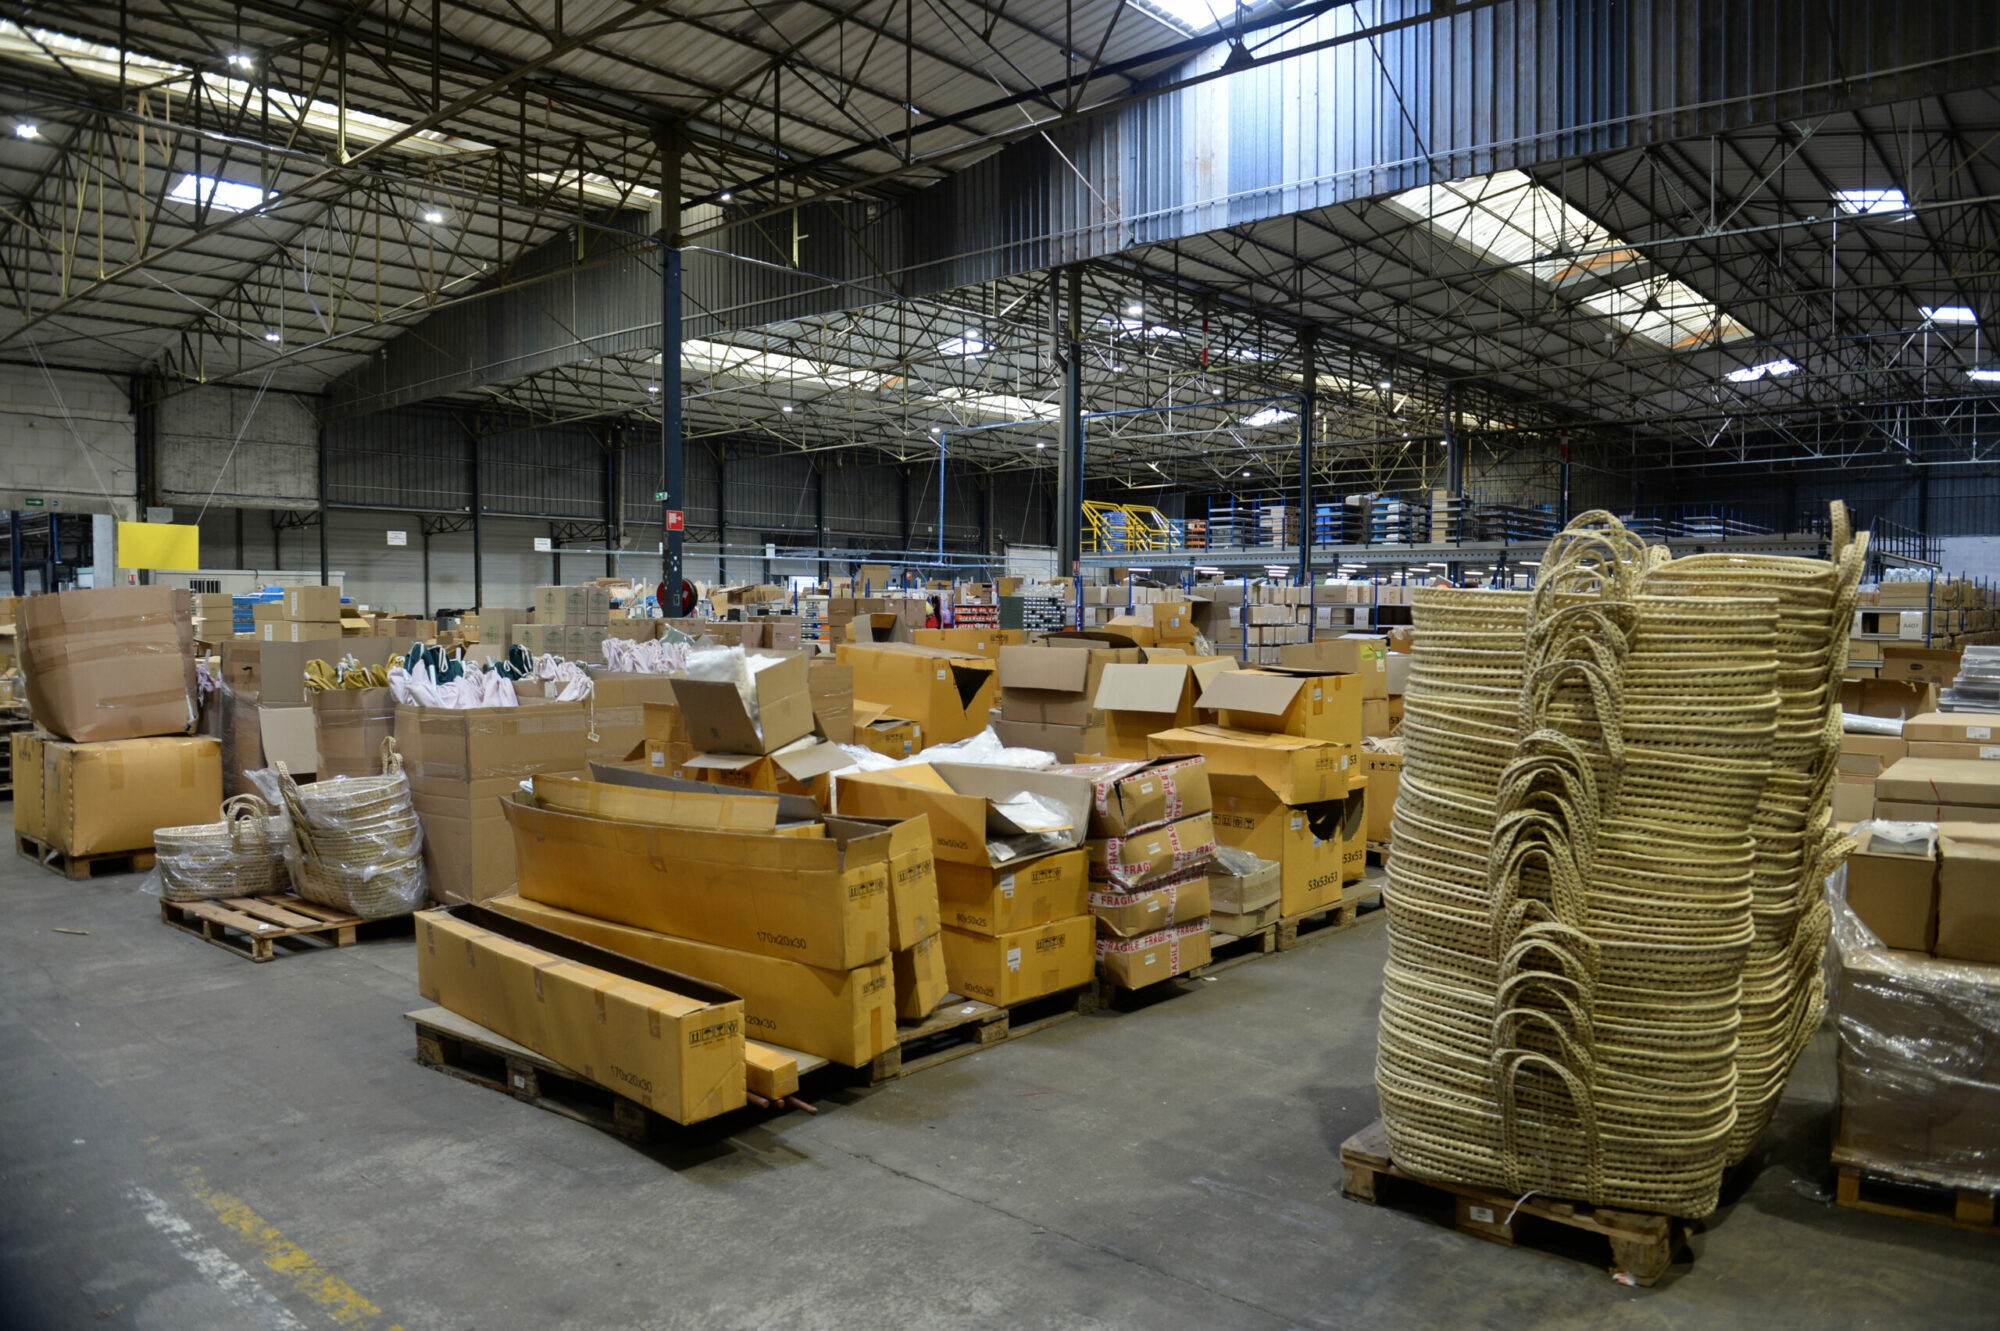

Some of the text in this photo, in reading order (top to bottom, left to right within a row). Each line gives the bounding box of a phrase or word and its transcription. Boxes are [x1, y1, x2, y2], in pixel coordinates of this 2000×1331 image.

[1308, 871, 1338, 891] 53x53x53
[1101, 893, 1140, 906] FRAGILE
[756, 931, 807, 949] 170x20x30
[964, 982, 995, 998] 80x50x25
[610, 1064, 653, 1093] 170x20x30
